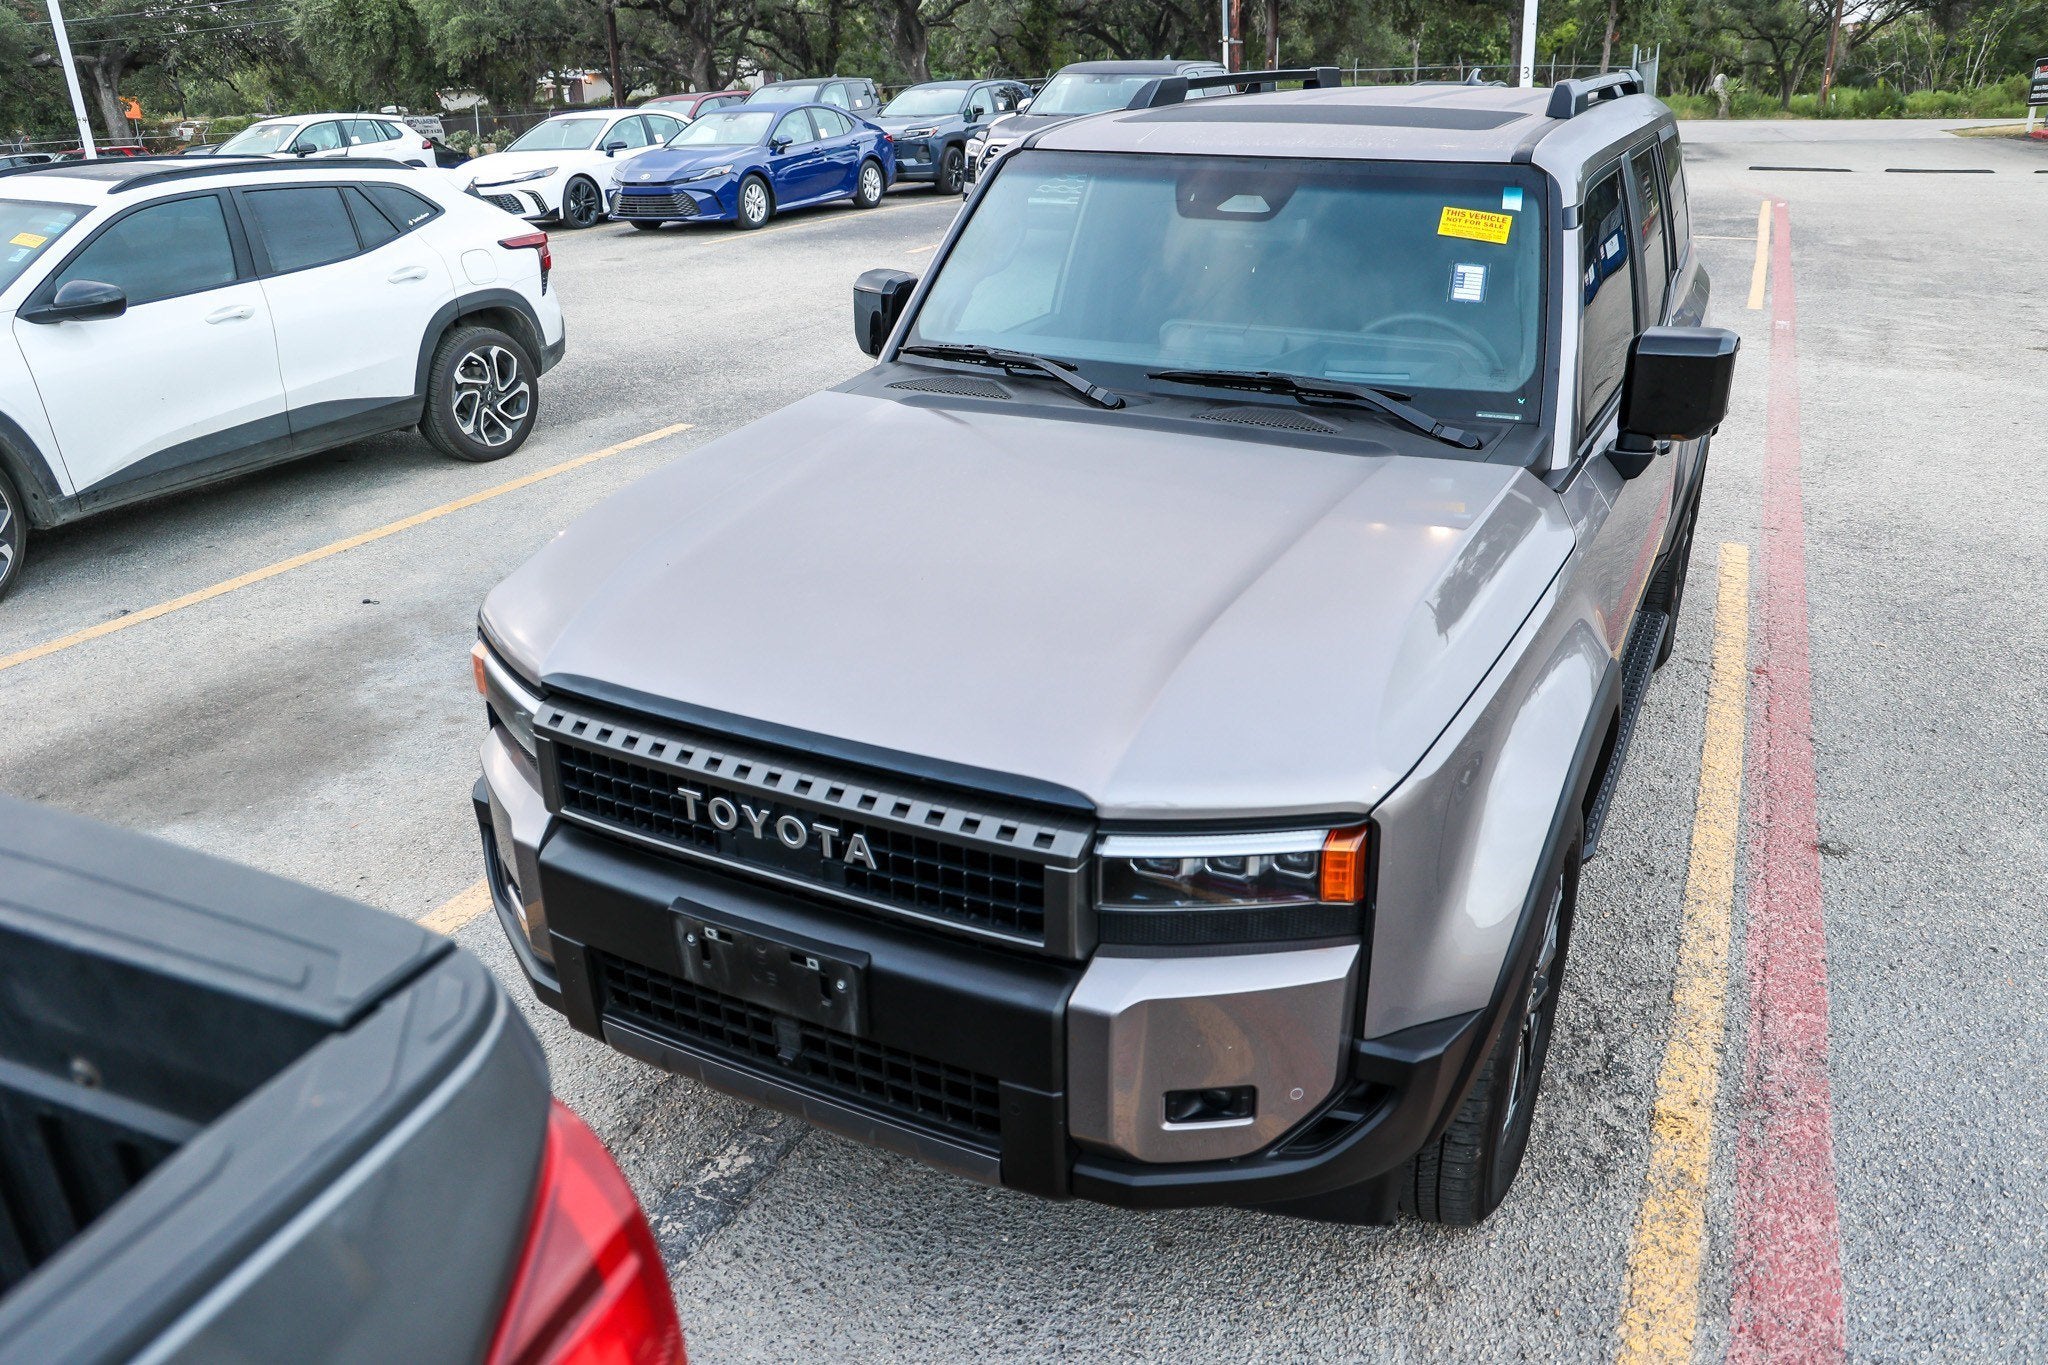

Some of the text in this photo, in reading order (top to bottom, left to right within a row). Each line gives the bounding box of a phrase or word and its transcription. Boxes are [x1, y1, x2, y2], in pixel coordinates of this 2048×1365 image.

[1523, 66, 1530, 80] 3
[1446, 209, 1508, 224] THIS VEHICLE
[1464, 218, 1481, 226] FOR
[1484, 221, 1504, 230] SALE
[677, 787, 877, 870] TOYOTA
